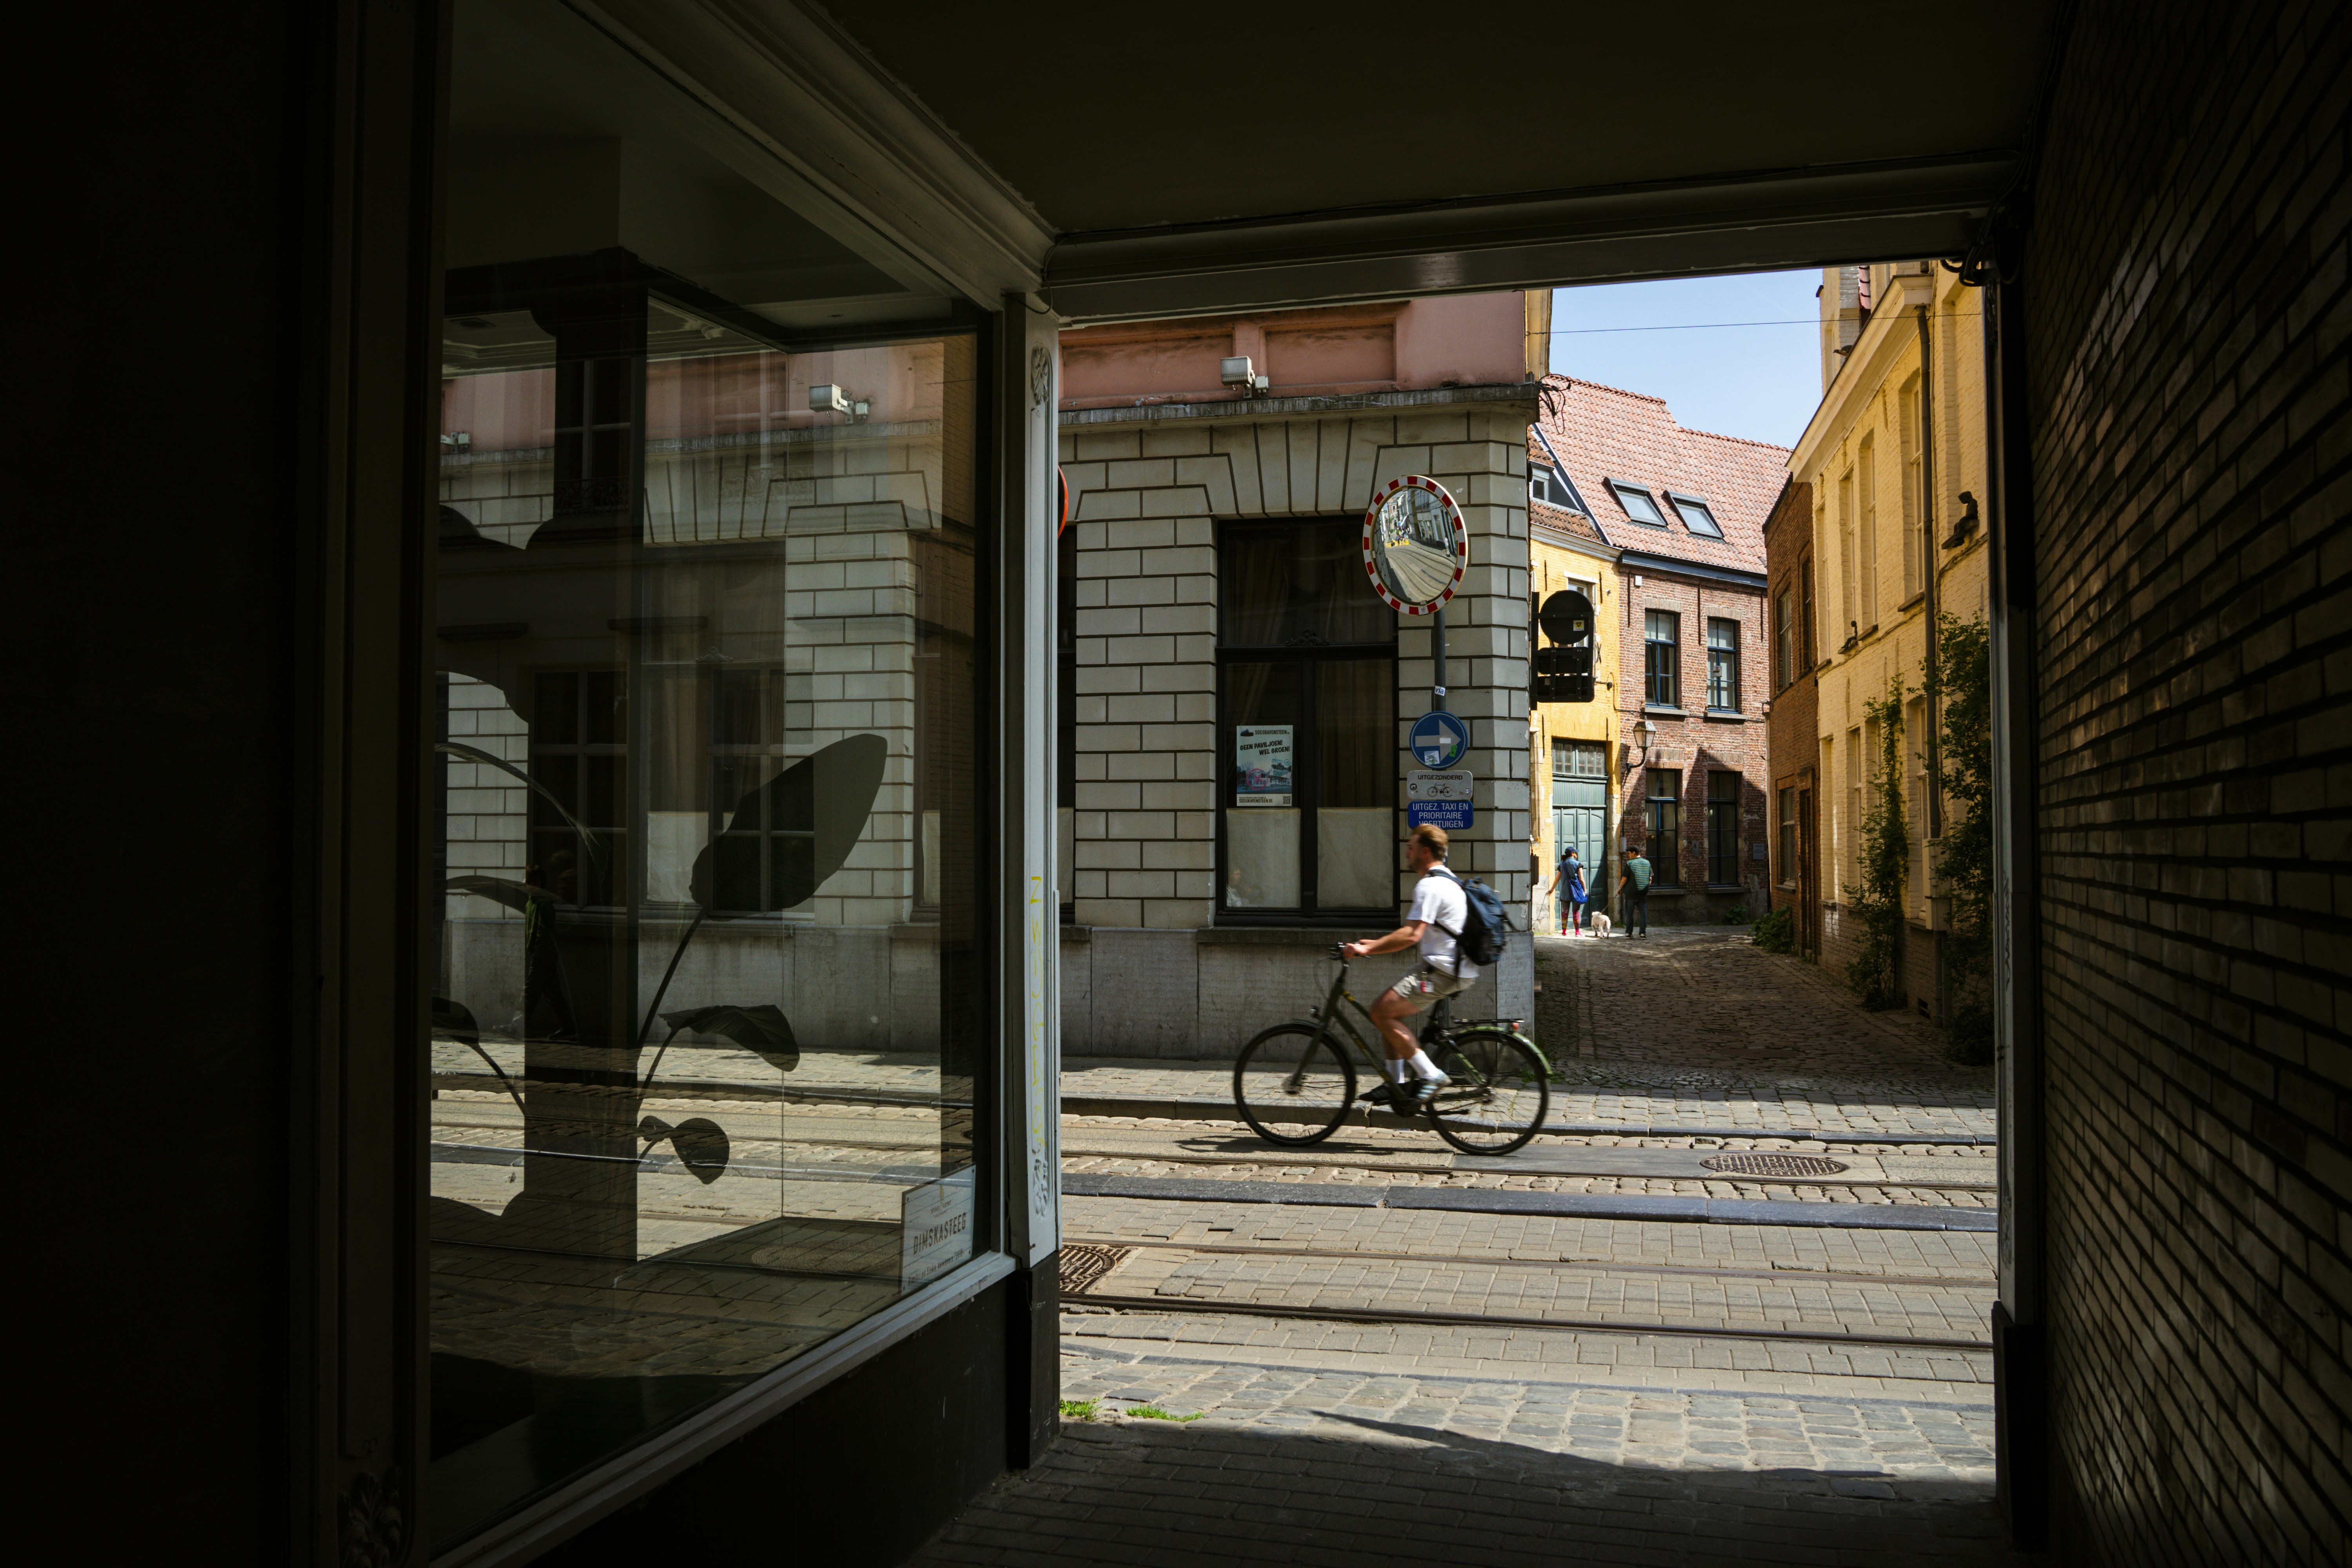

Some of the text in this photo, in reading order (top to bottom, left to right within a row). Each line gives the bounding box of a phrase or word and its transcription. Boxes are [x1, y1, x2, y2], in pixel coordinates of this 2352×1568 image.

[1254, 740, 1283, 749] PAVILJOEN!
[931, 1205, 940, 1214] STAD
[914, 1212, 966, 1255] DIMSKASTEEG
